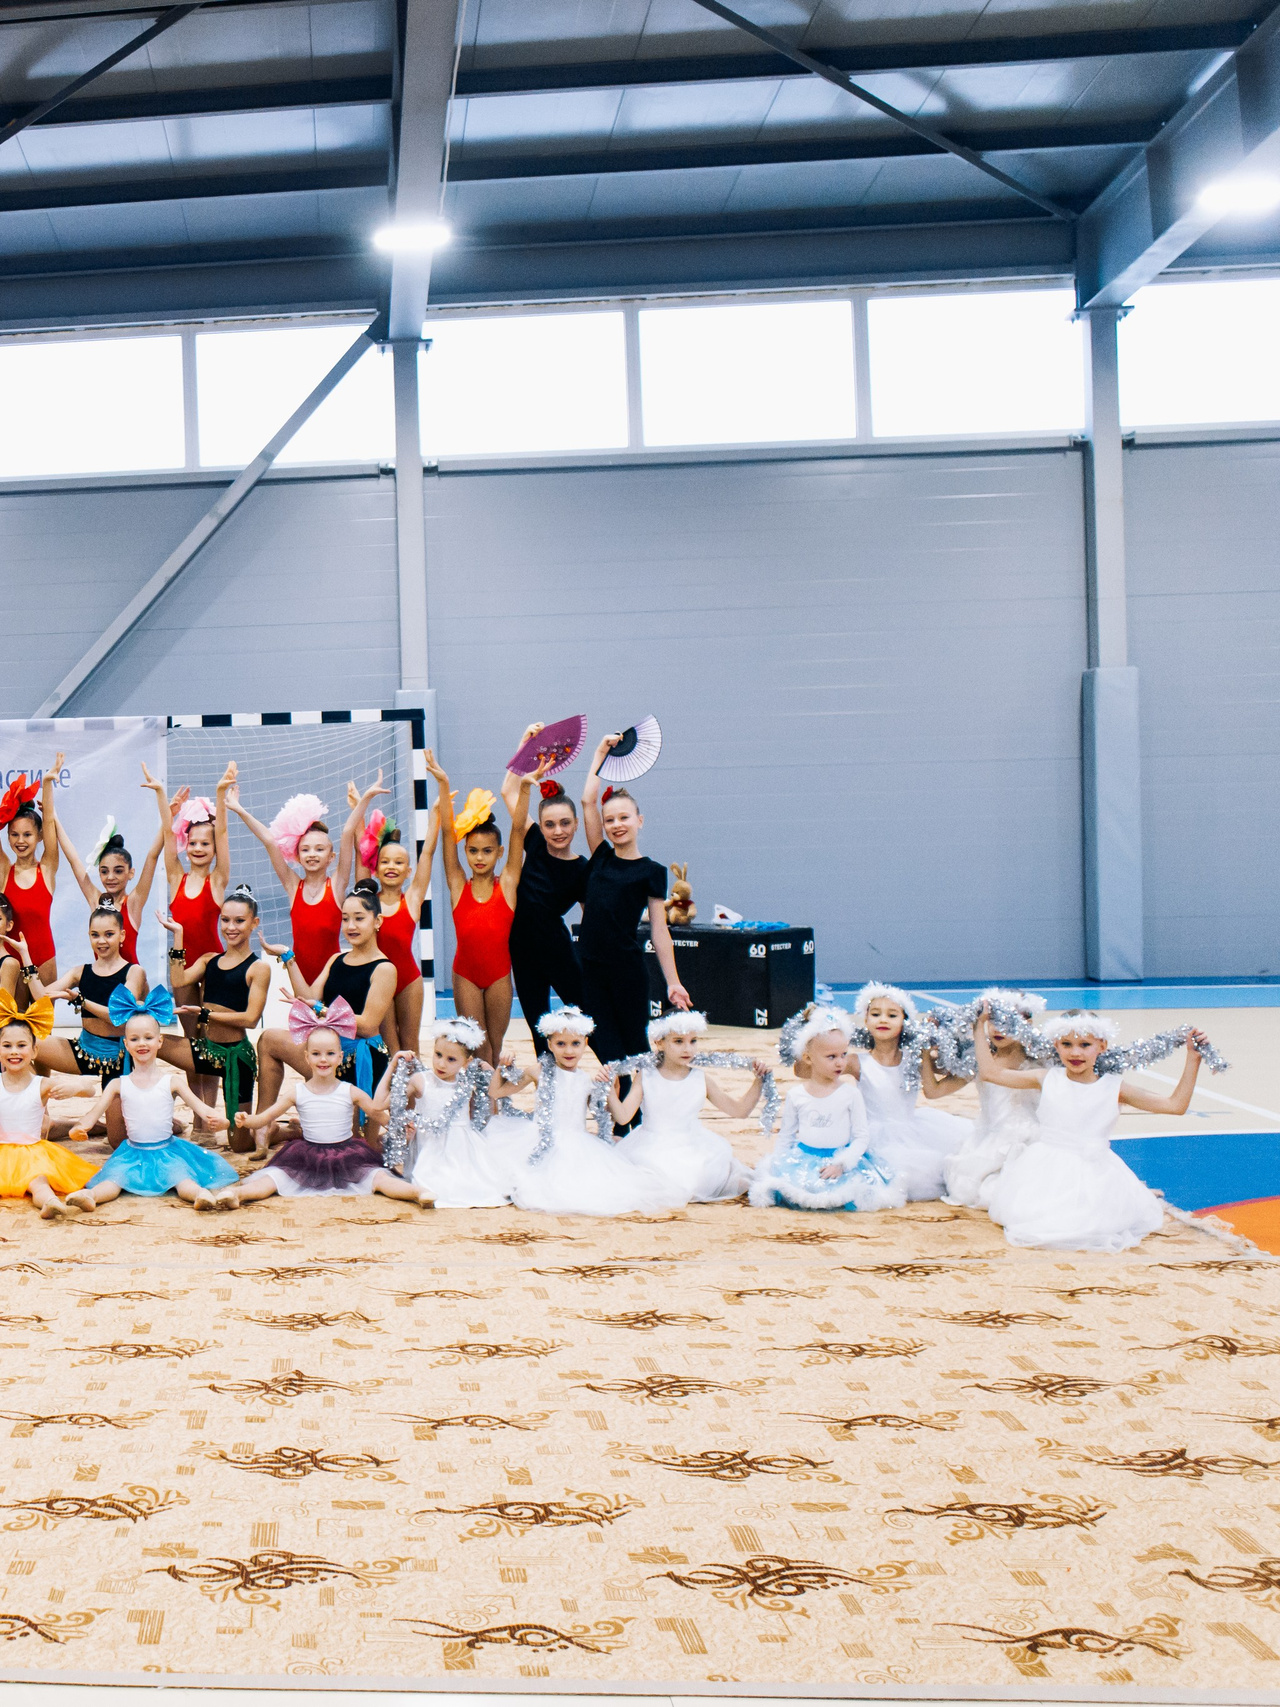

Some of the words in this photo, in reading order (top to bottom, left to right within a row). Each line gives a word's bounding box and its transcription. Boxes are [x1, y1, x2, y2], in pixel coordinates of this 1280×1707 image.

[645, 940, 656, 952] 6
[749, 944, 766, 957] 60
[803, 940, 814, 954] 60
[650, 1000, 662, 1017] 75
[756, 1008, 768, 1026] 75
